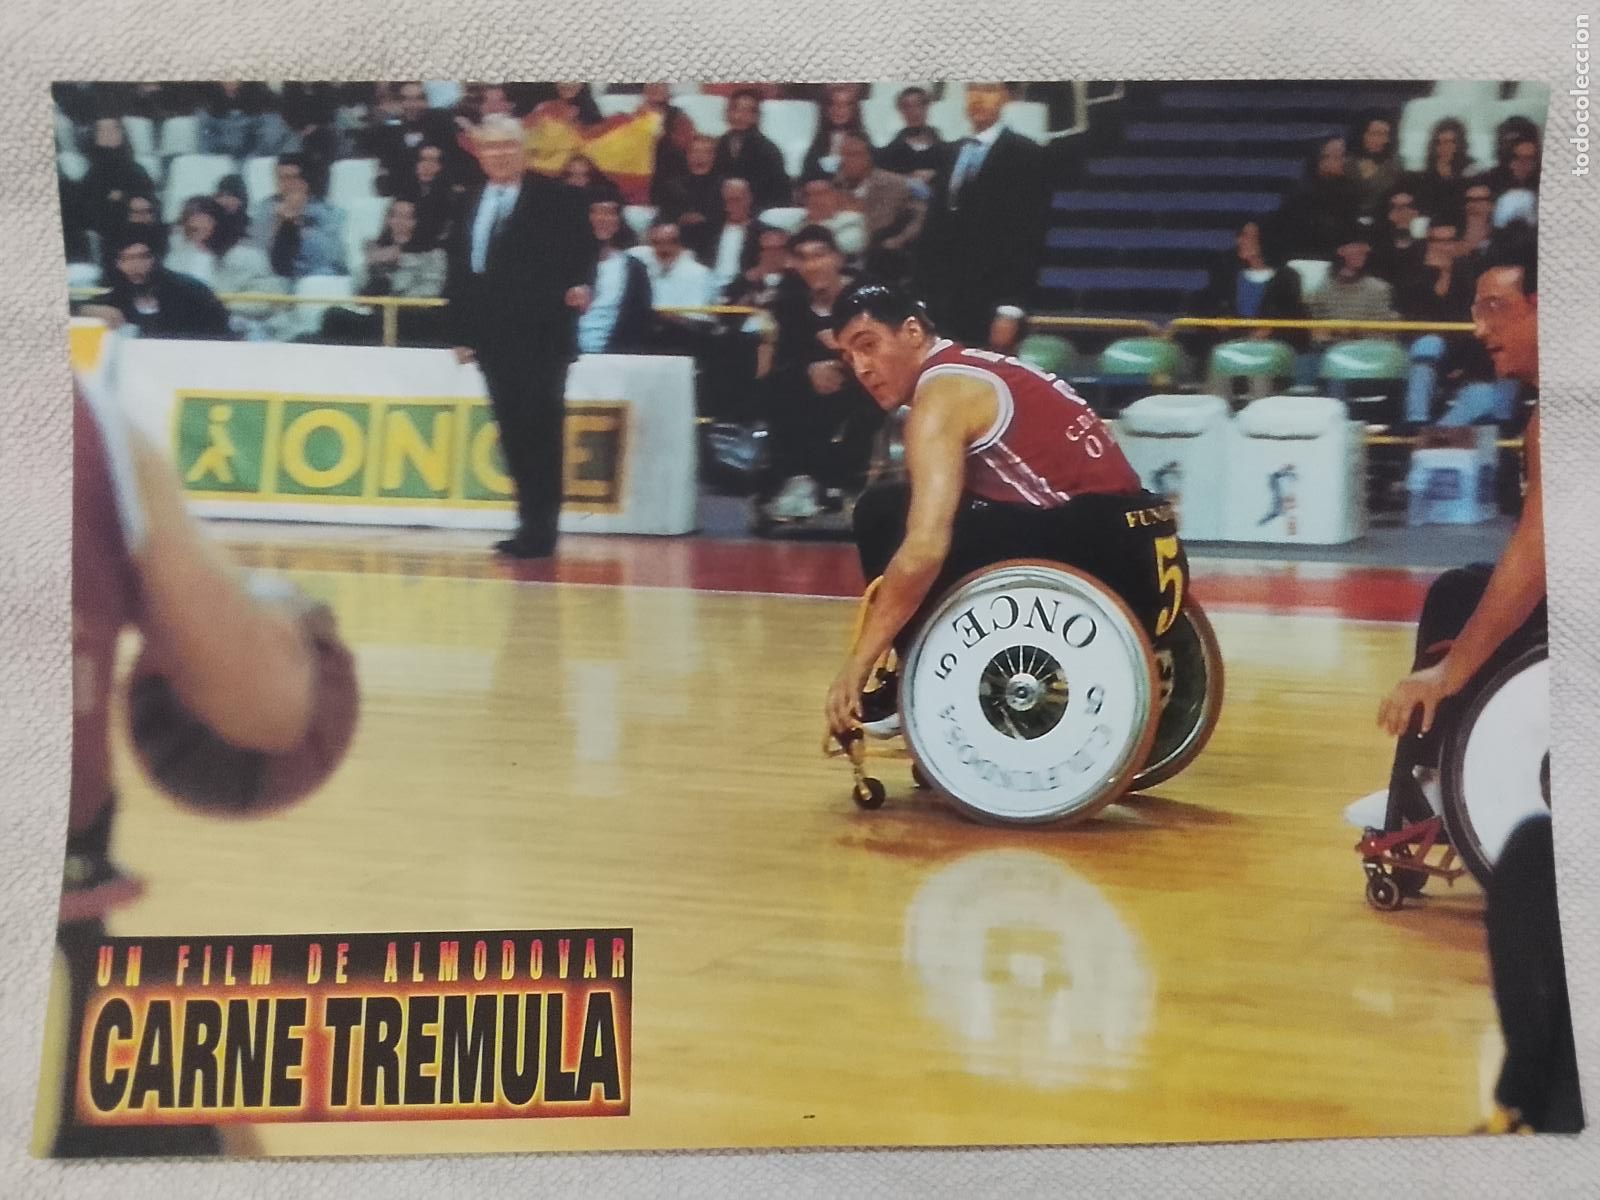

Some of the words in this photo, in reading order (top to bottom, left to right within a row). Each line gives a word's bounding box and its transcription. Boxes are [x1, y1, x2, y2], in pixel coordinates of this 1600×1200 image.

[952, 595, 1097, 649] ONCE
[1154, 536, 1184, 637] 5
[97, 944, 143, 987] UN
[176, 943, 273, 986] FILM
[307, 942, 350, 985] DE
[383, 937, 625, 984] ALMODOVAR
[89, 996, 308, 1112] CARNE
[325, 991, 622, 1106] TREMULA
